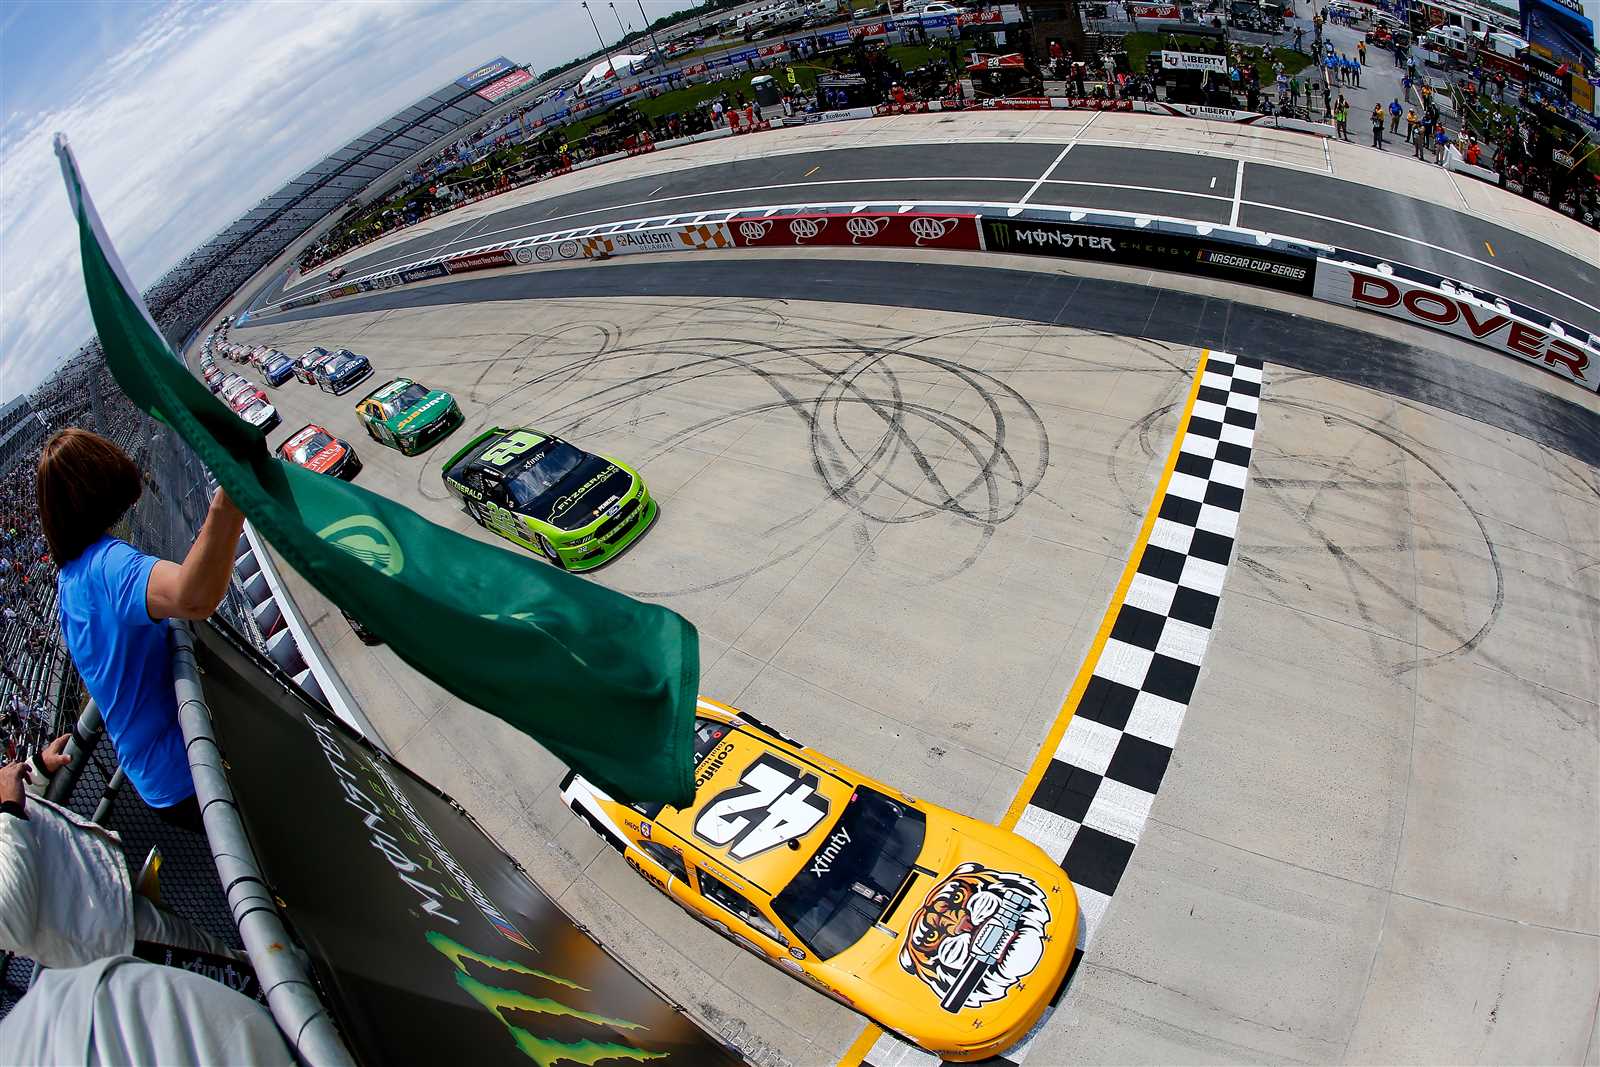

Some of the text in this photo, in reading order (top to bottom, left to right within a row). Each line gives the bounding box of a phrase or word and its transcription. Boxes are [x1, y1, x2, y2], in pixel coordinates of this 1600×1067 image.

[988, 58, 999, 67] 24
[1181, 55, 1225, 66] LIBERTY
[1538, 70, 1563, 86] VISION
[983, 98, 996, 107] 24
[1200, 106, 1236, 117] LIBERTY
[825, 111, 851, 119] EcoBoost
[743, 221, 765, 238] AAA
[791, 219, 817, 237] AAA
[849, 218, 876, 237] AAA
[913, 219, 944, 238] AAA
[627, 231, 673, 246] Autism
[639, 242, 676, 251] DELAWARE
[1015, 228, 1191, 256] MONSTER ENERGY
[1209, 252, 1307, 279] NASCAR CUP SERIES
[1348, 270, 1592, 382] DOVER
[398, 392, 447, 431] SUBWAY
[480, 431, 547, 466] 22
[523, 451, 546, 470] xfinity
[447, 477, 483, 501] FITZGERALD
[557, 465, 616, 511] FITZGERALD
[486, 500, 519, 537] 22
[693, 751, 830, 862] 42
[303, 712, 460, 924] MONSTER
[810, 826, 853, 878] xfinity
